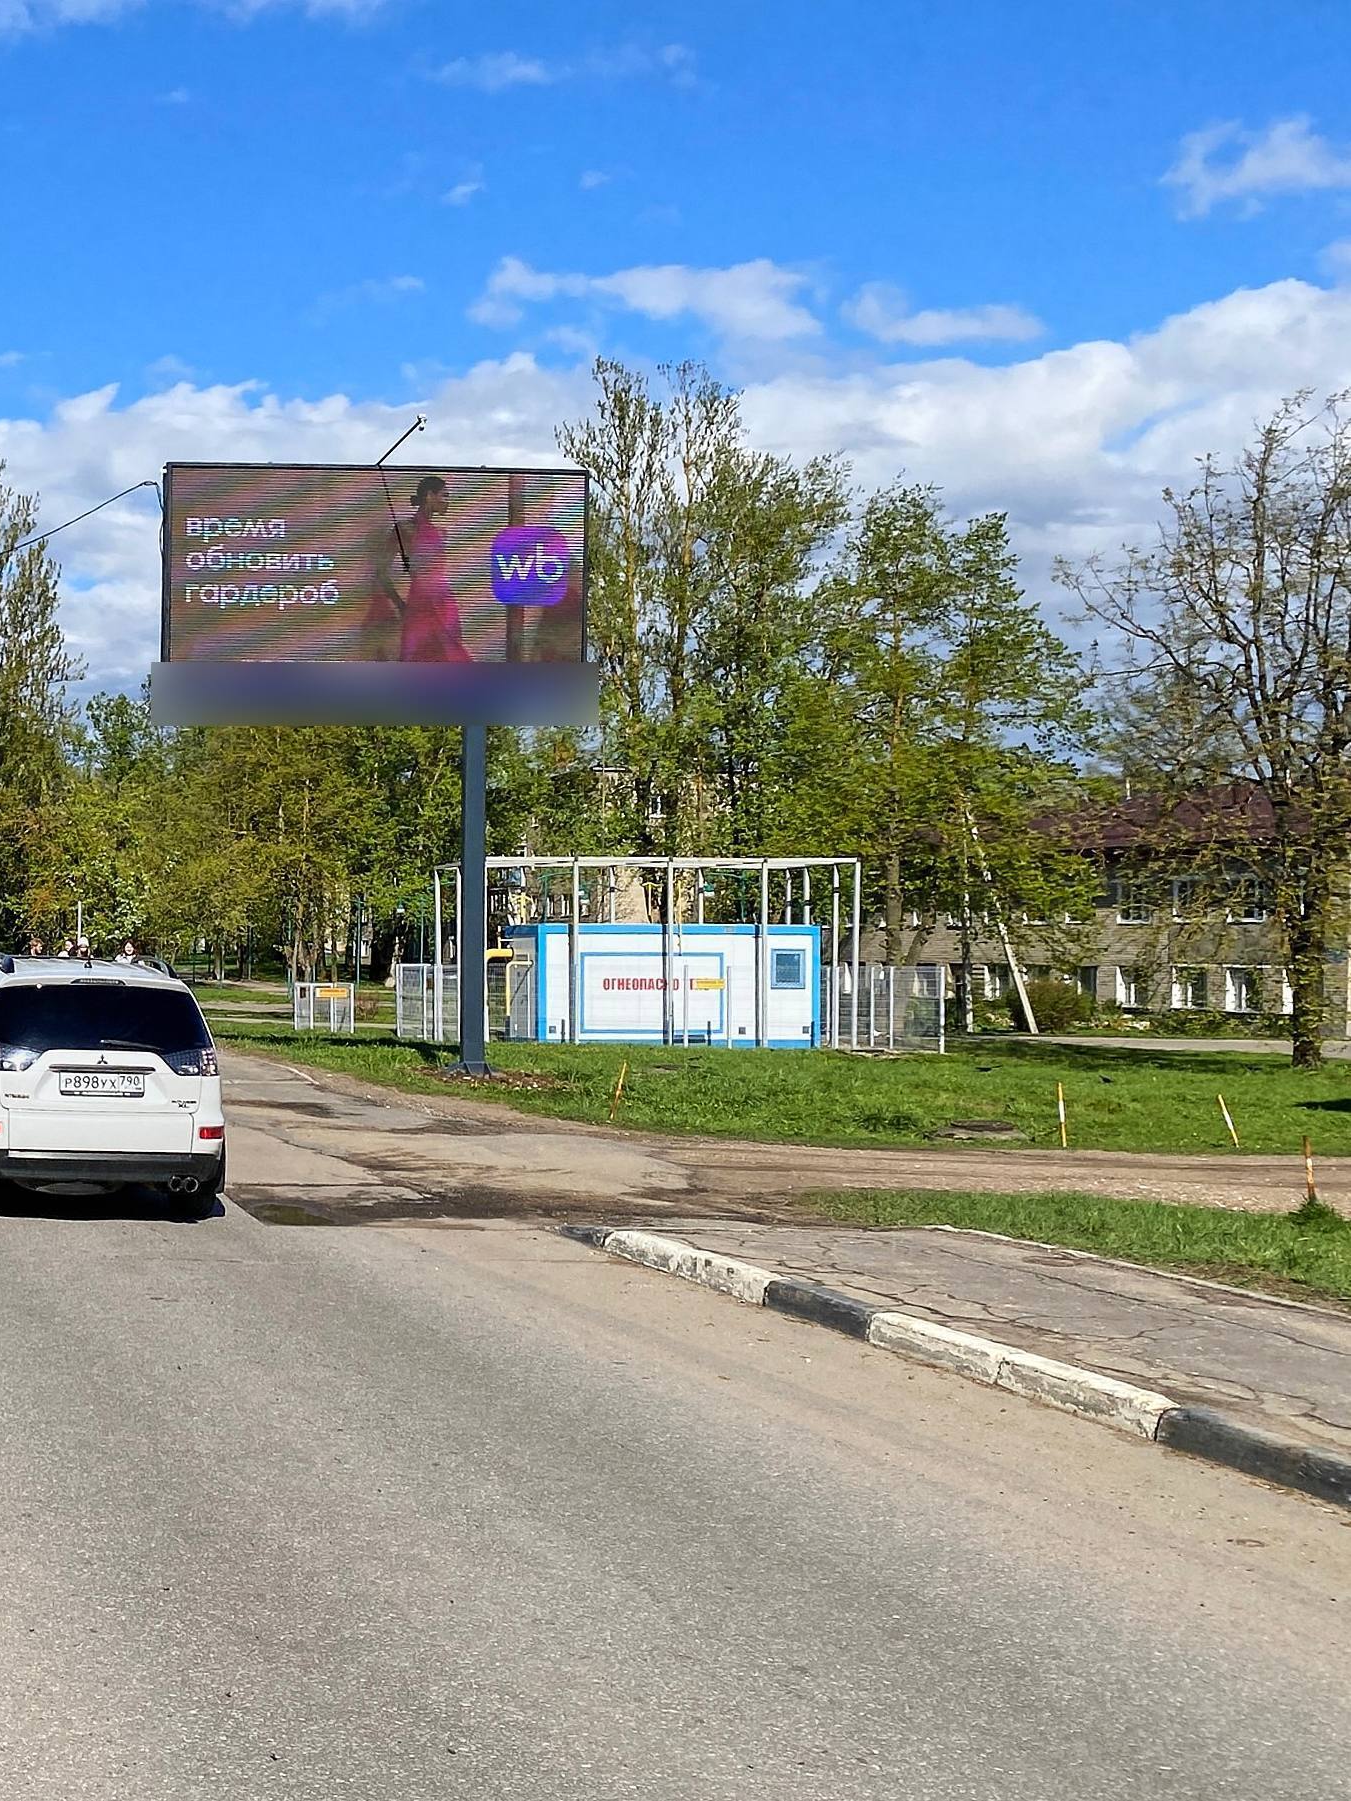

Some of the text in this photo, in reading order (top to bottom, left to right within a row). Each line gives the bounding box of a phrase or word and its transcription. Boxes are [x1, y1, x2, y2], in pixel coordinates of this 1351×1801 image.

[185, 517, 286, 543] время
[185, 544, 335, 570] обновить
[496, 542, 565, 583] wb
[185, 579, 340, 610] гардероб
